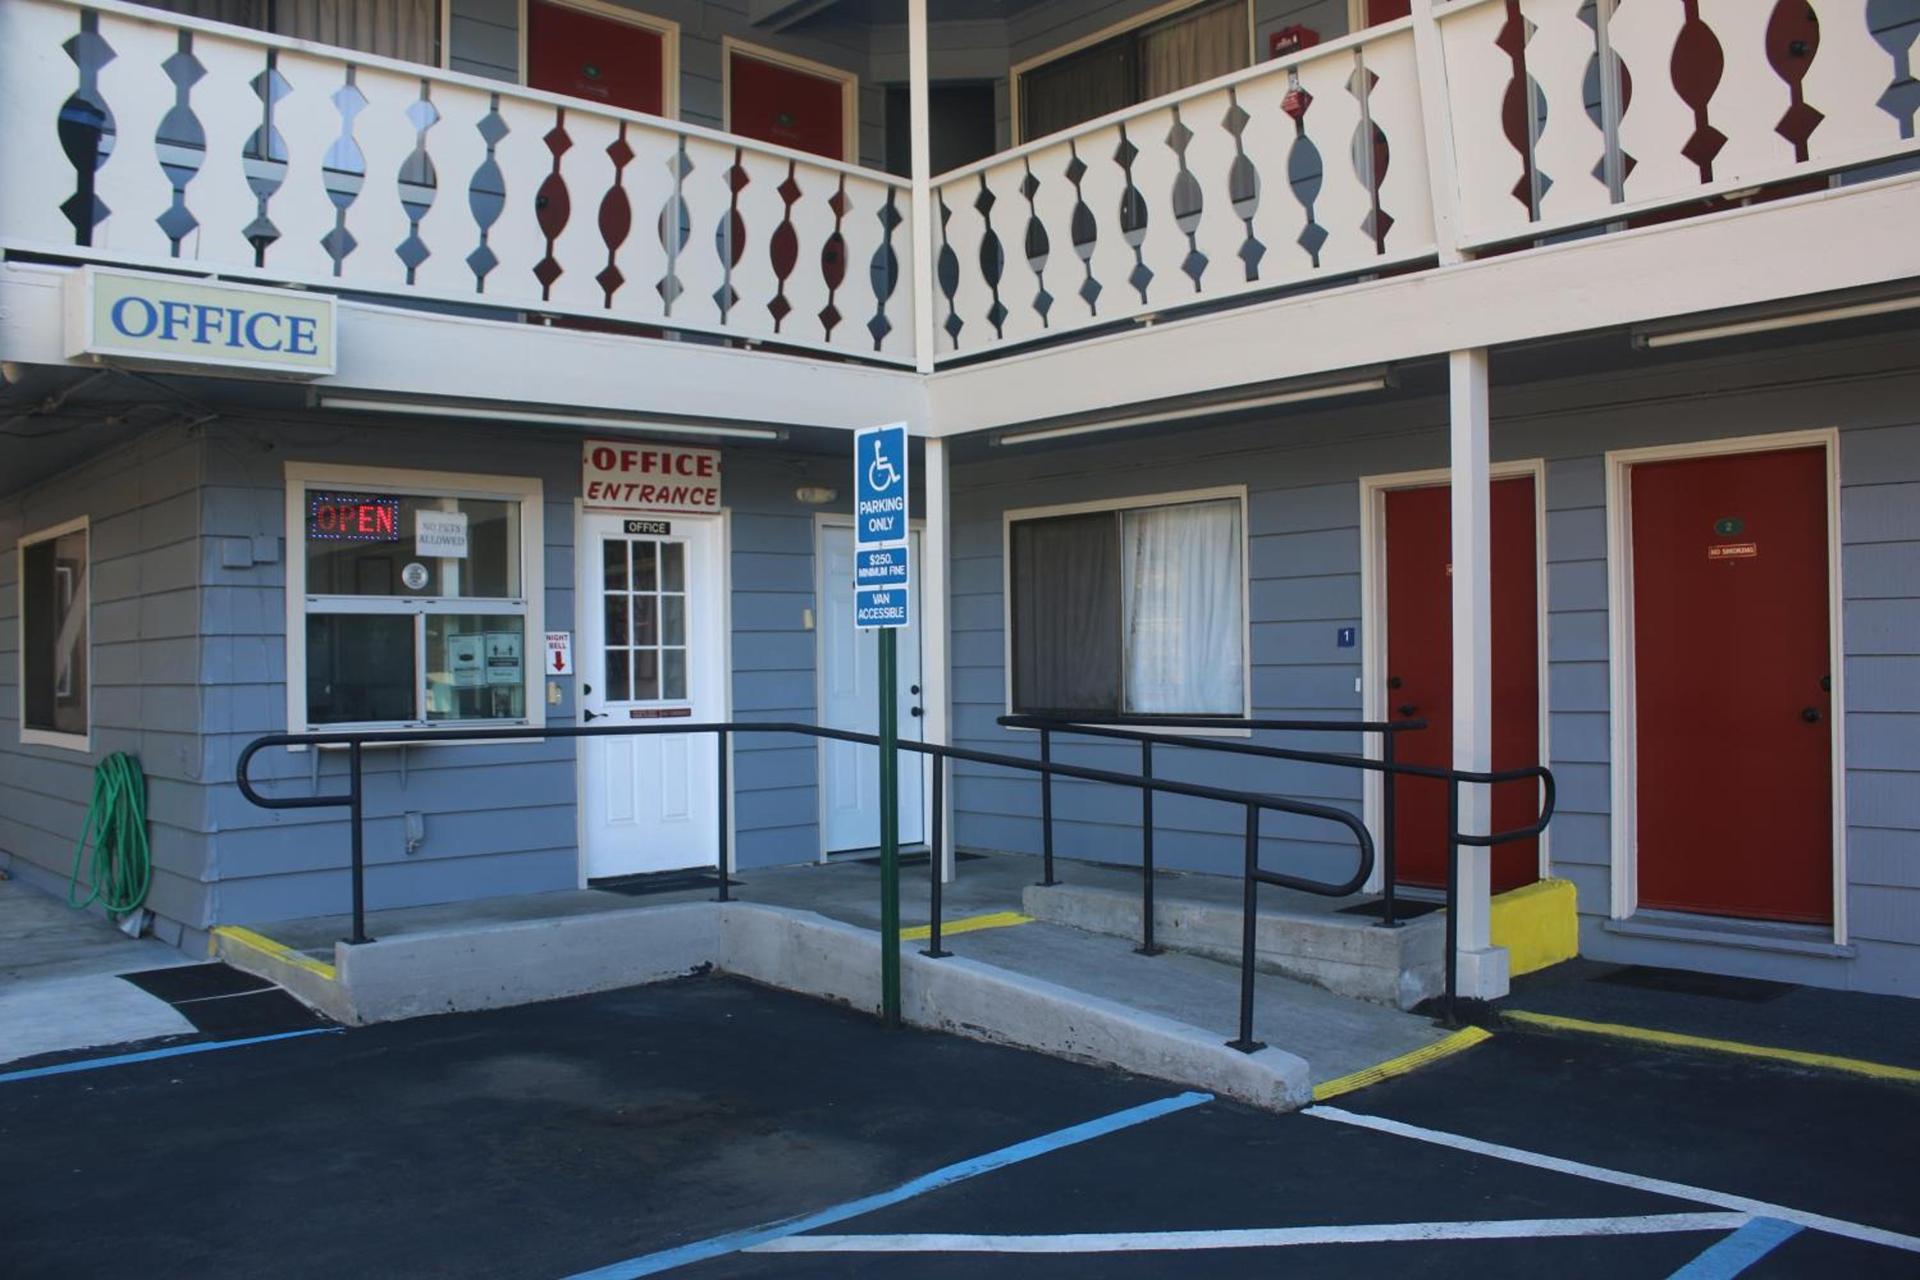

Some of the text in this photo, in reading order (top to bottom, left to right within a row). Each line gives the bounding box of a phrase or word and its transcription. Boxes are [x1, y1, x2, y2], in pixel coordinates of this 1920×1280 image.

[111, 296, 318, 355] OFFICE
[592, 447, 713, 477] OFFICE
[587, 481, 717, 506] ENTRANCE
[860, 497, 903, 515] PARKING
[317, 504, 393, 533] OPEN
[868, 516, 894, 532] ONLY
[423, 523, 461, 534] NO PETS
[628, 521, 666, 534] OFFICE
[419, 534, 465, 546] ALLOWED
[869, 553, 893, 566] $250.
[858, 565, 906, 578] MINIMUM FINE
[872, 593, 890, 605] VAN
[858, 606, 905, 619] ACCESSIBLE
[1343, 630, 1349, 642] 1
[549, 642, 566, 650] BELL
